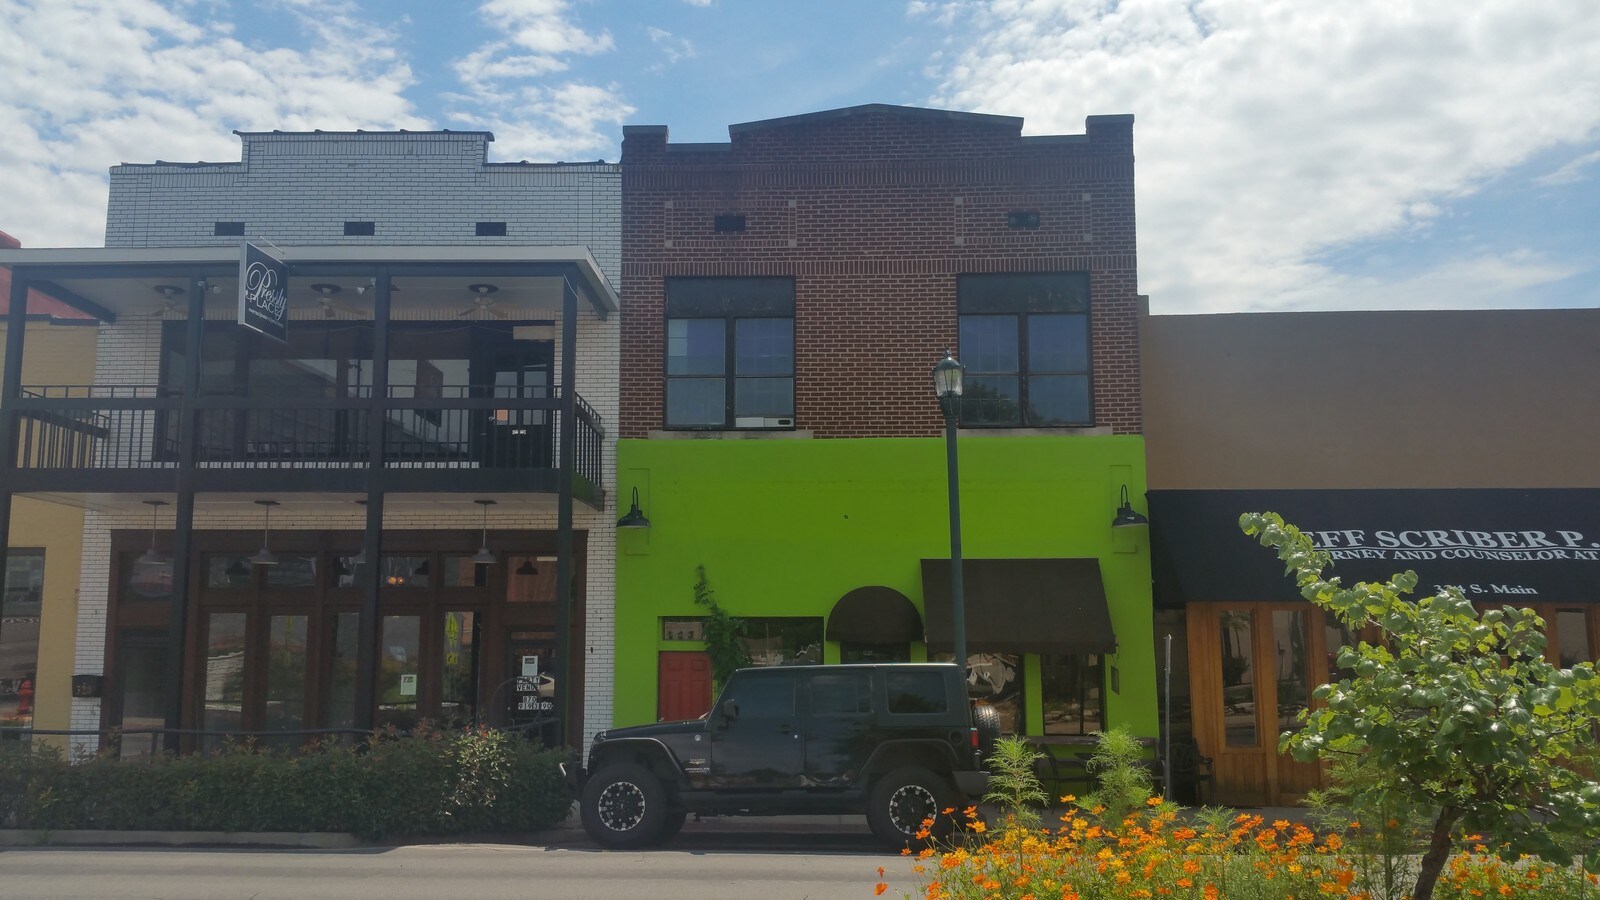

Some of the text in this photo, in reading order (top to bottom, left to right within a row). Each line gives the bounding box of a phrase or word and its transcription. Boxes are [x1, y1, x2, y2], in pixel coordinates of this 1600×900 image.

[1375, 529, 1557, 549] SCRIBER
[1393, 550, 1437, 560] AND
[1440, 549, 1572, 561] COUNSELOR
[1574, 550, 1600, 560] AT
[1469, 583, 1488, 594] S.
[1490, 583, 1539, 595] Main
